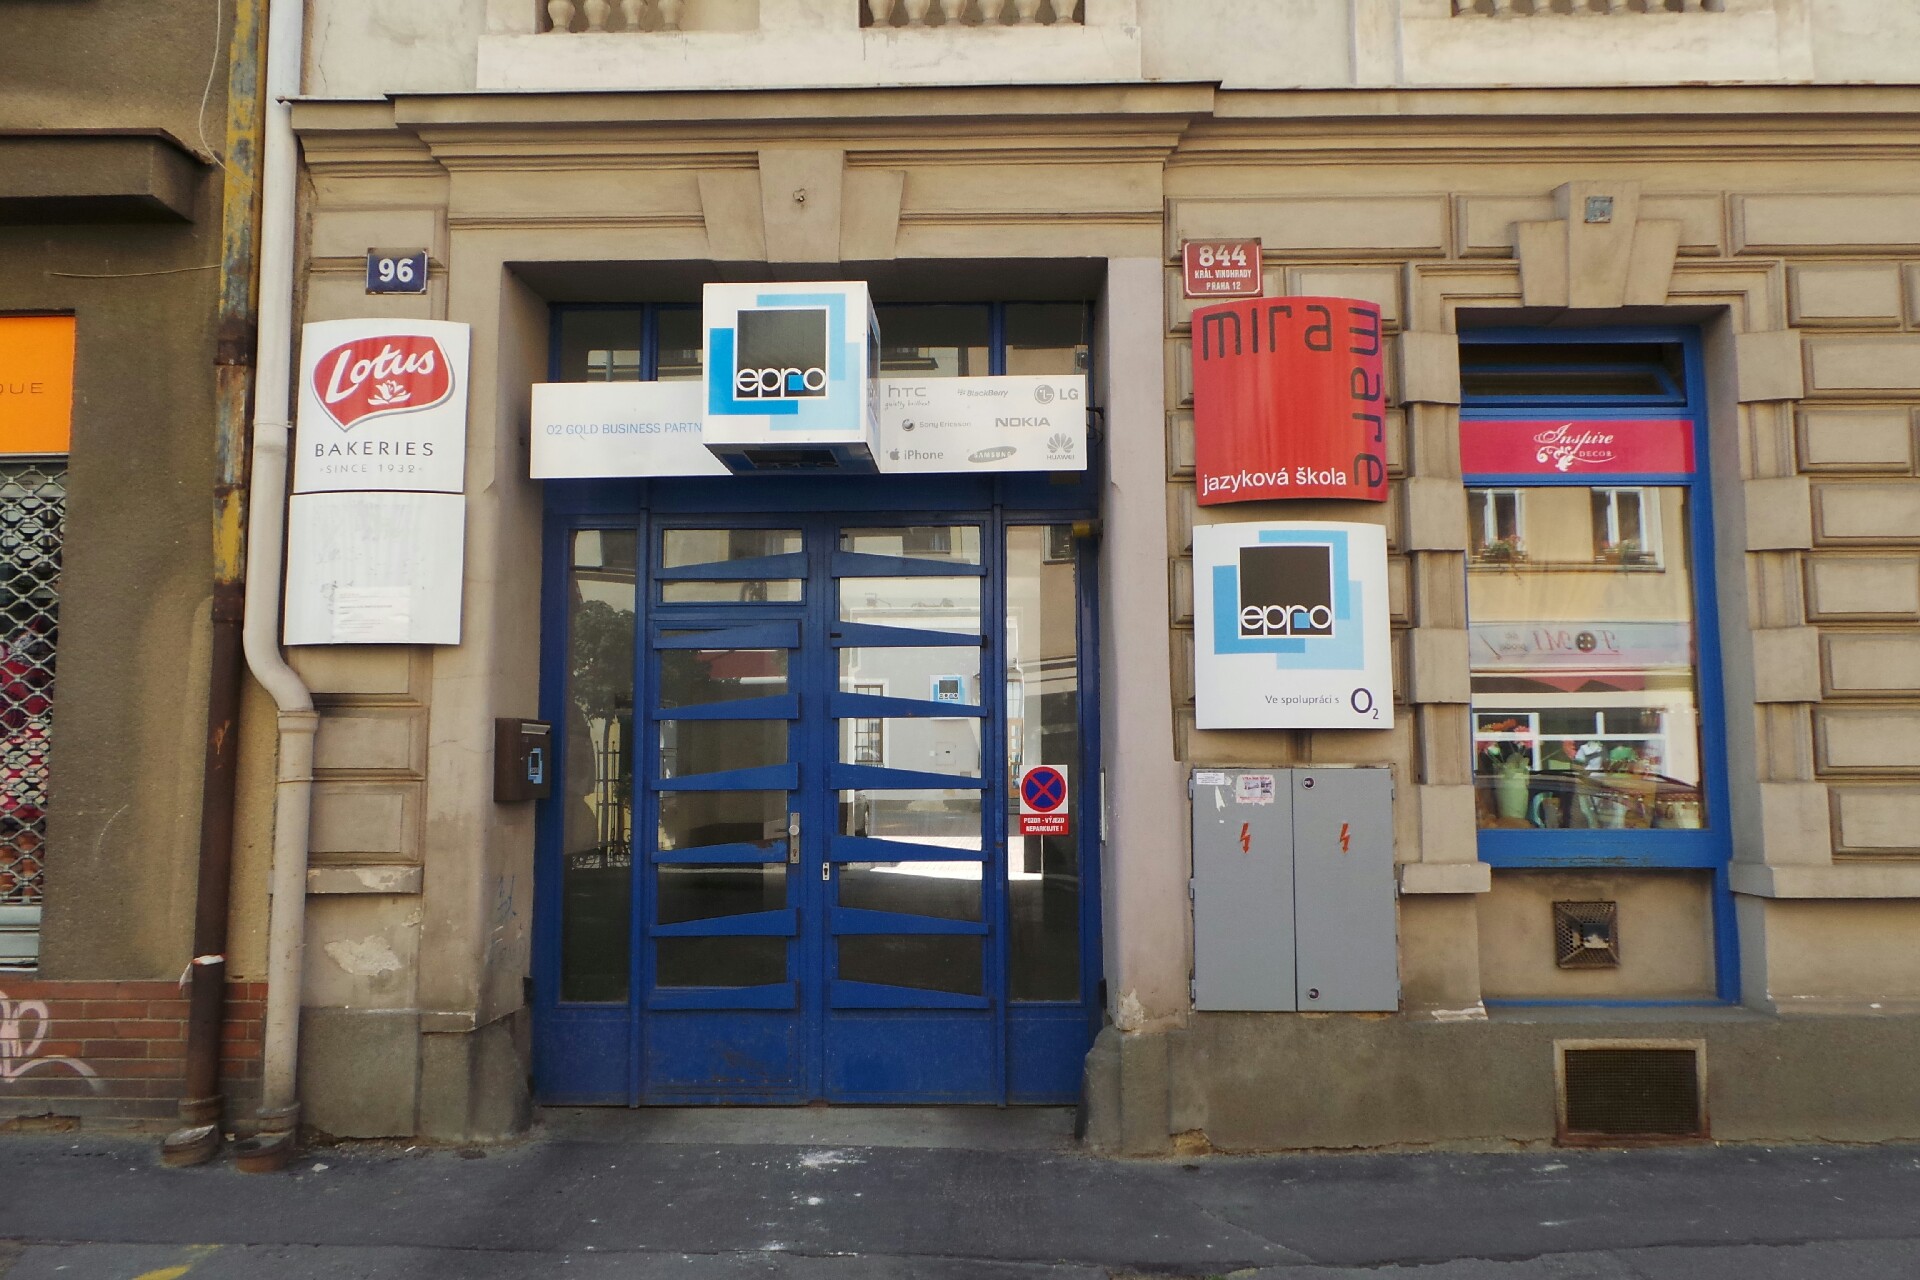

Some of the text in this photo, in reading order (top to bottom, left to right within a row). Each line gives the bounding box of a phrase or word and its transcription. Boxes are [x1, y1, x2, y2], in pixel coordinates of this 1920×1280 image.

[1199, 245, 1247, 267] 844
[379, 258, 414, 283] 96
[1215, 269, 1252, 279] VINOHRADY
[1206, 282, 1241, 291] PRAHA 12
[1202, 304, 1333, 361] mira
[325, 343, 435, 405] Lotus
[0, 382, 44, 395] UE
[736, 367, 827, 398] epro
[967, 389, 1009, 398] BlackBerry
[1059, 388, 1079, 401] LG
[1348, 306, 1384, 488] mare
[566, 423, 599, 435] GOLD
[602, 422, 661, 434] BUSINESS
[919, 420, 972, 430] Sony Ericsson
[995, 417, 1051, 428] NOKIA
[1534, 423, 1614, 458] Inspire
[315, 441, 434, 458] BAKERIES
[904, 449, 944, 461] iPhone
[973, 449, 1012, 460] SAMSUNG
[1579, 450, 1612, 458] DECOR
[326, 464, 415, 474] SINCE 1932
[1202, 467, 1347, 497] jazyková škola
[1240, 605, 1333, 637] epro
[1265, 694, 1340, 706] Ve spolupráci s
